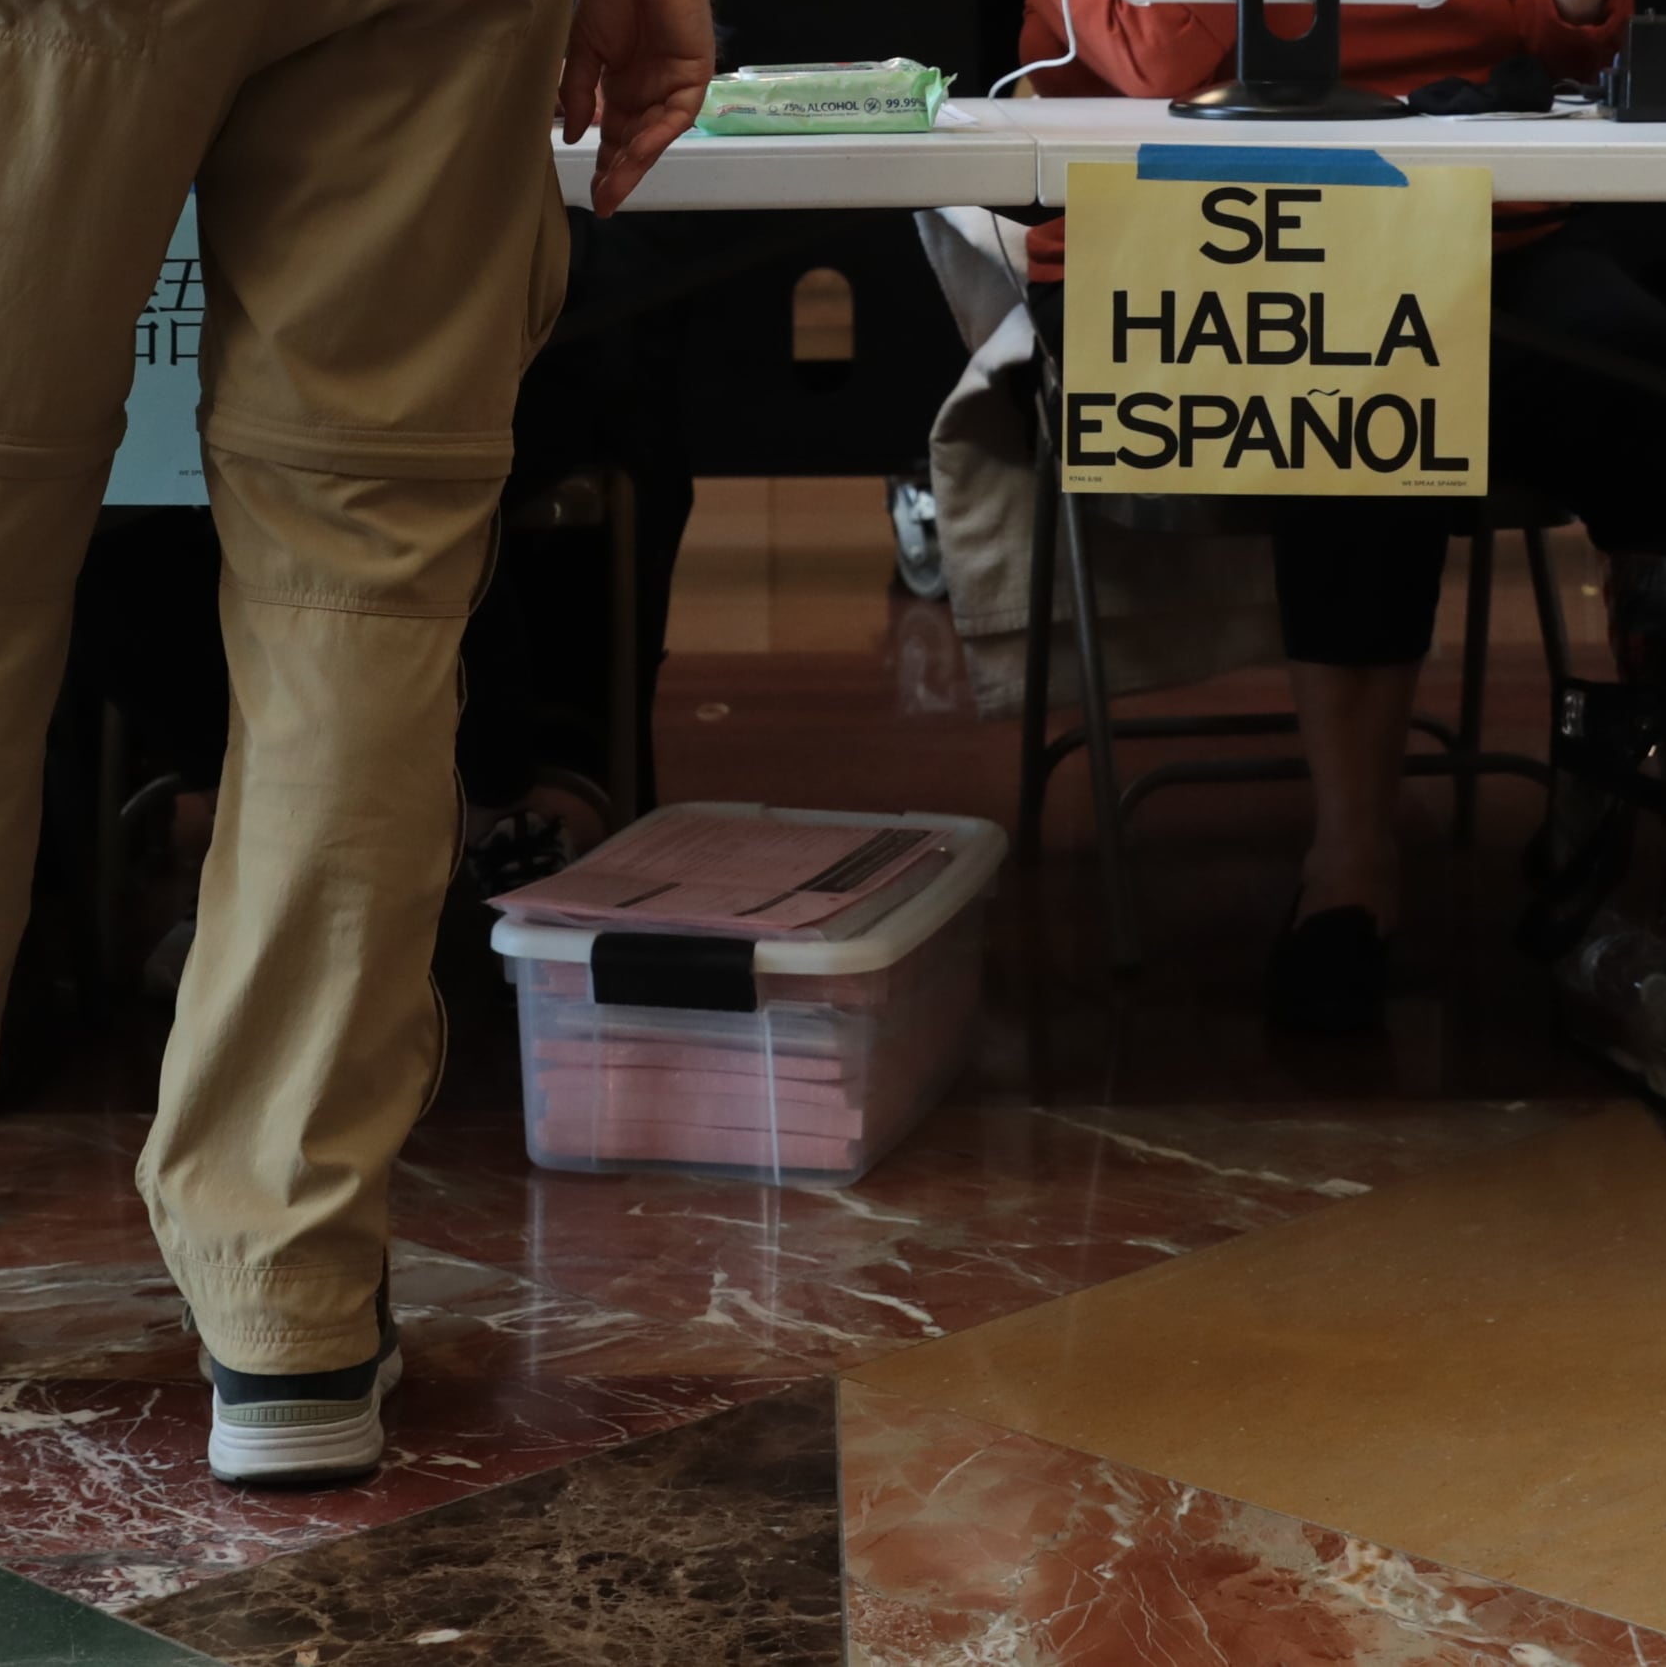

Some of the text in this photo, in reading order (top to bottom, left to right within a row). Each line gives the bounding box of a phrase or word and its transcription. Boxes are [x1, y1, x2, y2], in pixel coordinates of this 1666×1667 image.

[782, 101, 859, 114] 75% ALCOHOL
[1199, 187, 1325, 264] SE
[1112, 290, 1440, 367] HABLA
[1067, 389, 1469, 473] ESPAÑOL
